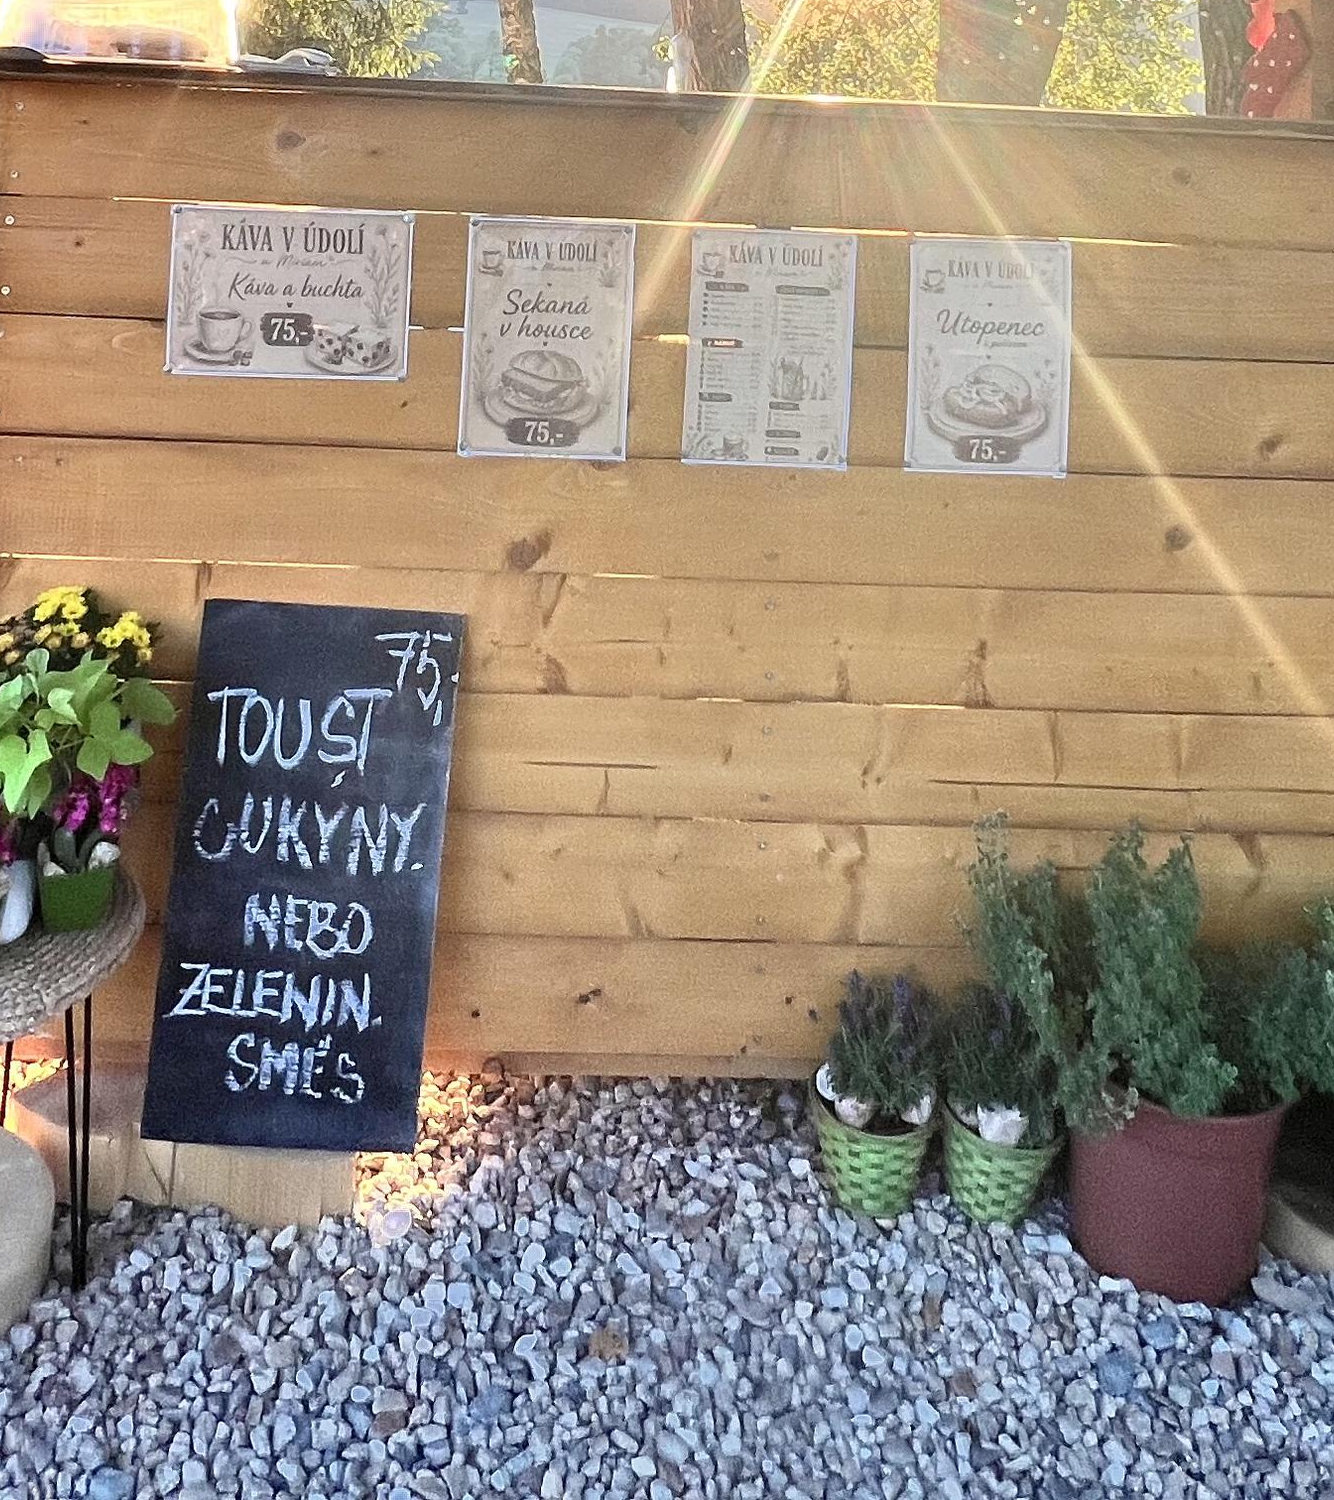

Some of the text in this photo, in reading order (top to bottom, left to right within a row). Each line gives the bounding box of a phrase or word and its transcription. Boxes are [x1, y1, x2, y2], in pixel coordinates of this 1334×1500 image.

[221, 218, 365, 254] KÁVA V ÚDOLÍ
[507, 237, 598, 261] KÁVA V ÚDOLÍ
[729, 240, 823, 267] KÁVA V ÚDOLÍ
[985, 261, 993, 278] V
[228, 272, 365, 300] Káva a buchta
[503, 288, 592, 316] Sekaná
[270, 318, 308, 344] 75,-
[500, 316, 594, 341] v housce
[936, 308, 1045, 345] Utopenec
[525, 421, 564, 443] 75,-
[970, 439, 1006, 461] 75,-
[207, 686, 393, 775] TOUST
[244, 893, 374, 959] NEBO
[163, 963, 383, 1033] ZELENIN.
